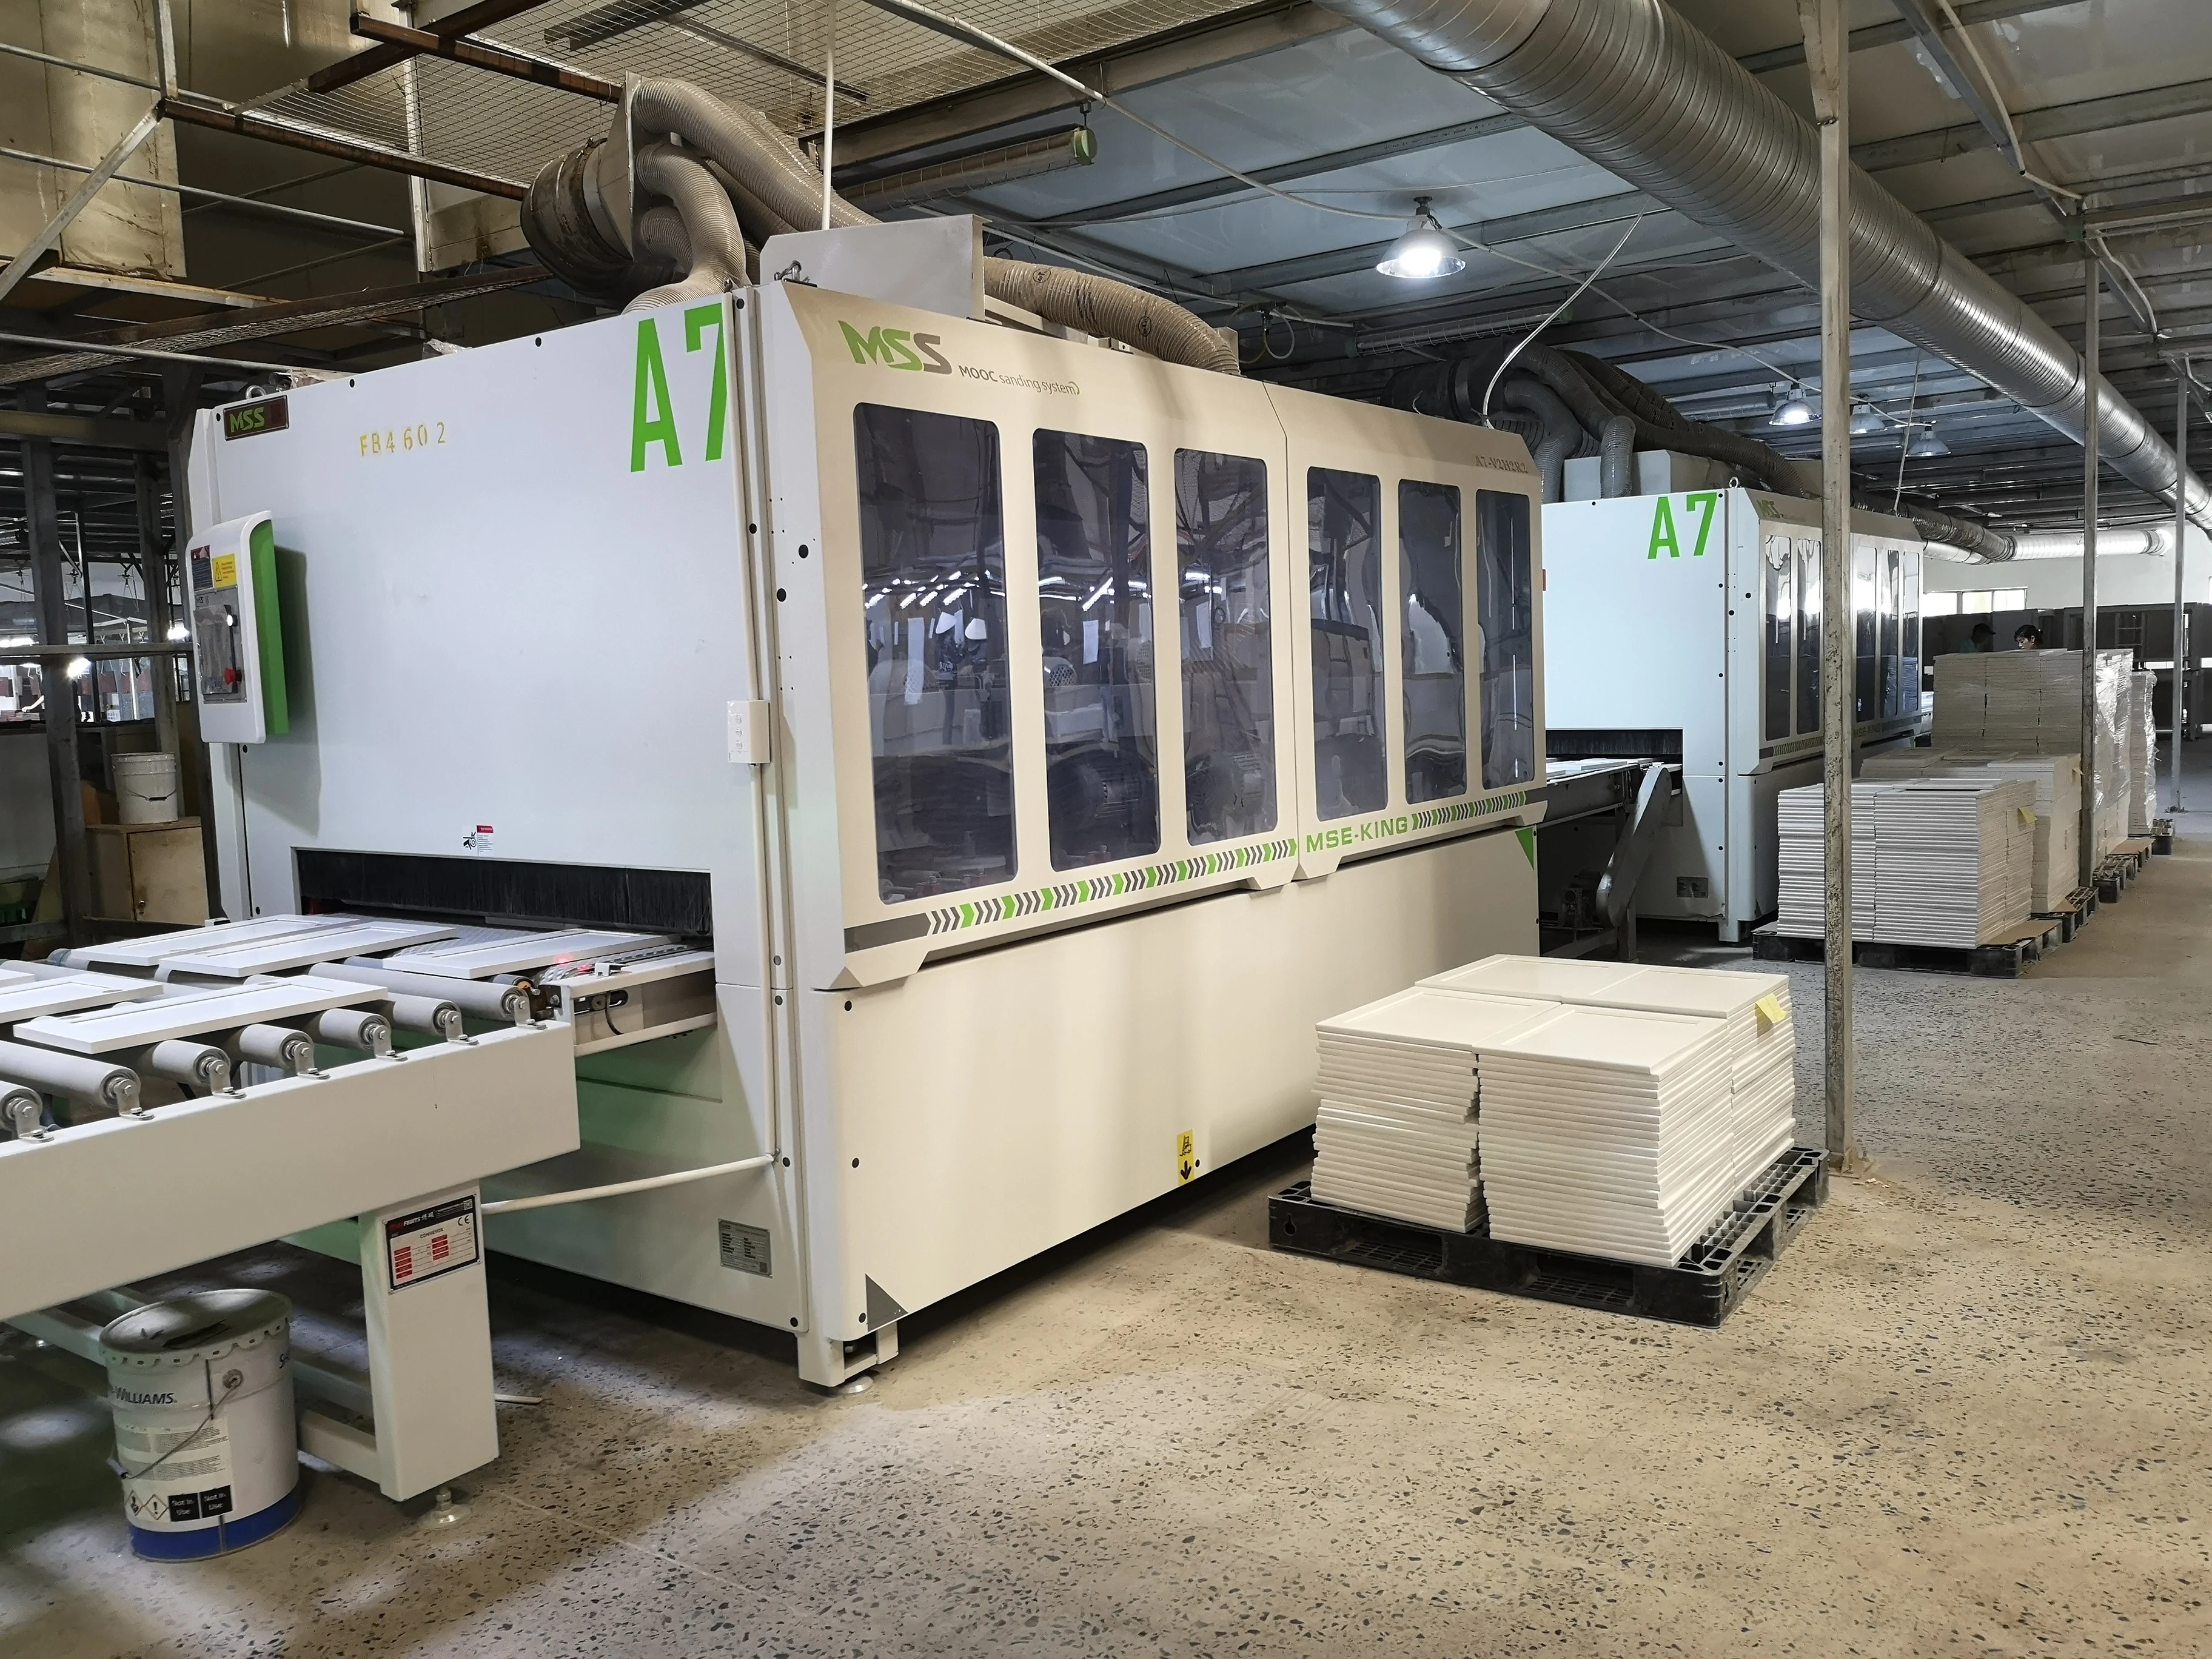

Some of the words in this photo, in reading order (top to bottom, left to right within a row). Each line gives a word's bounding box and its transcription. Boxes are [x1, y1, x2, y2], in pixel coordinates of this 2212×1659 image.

[631, 303, 727, 472] A7
[838, 320, 952, 374] MSS
[958, 365, 997, 383] MOOC
[1000, 374, 1041, 392] sanding
[1041, 380, 1076, 395] system
[230, 407, 265, 433] MSS
[1647, 492, 1717, 559] A7
[1307, 816, 1407, 853] MSE-KING
